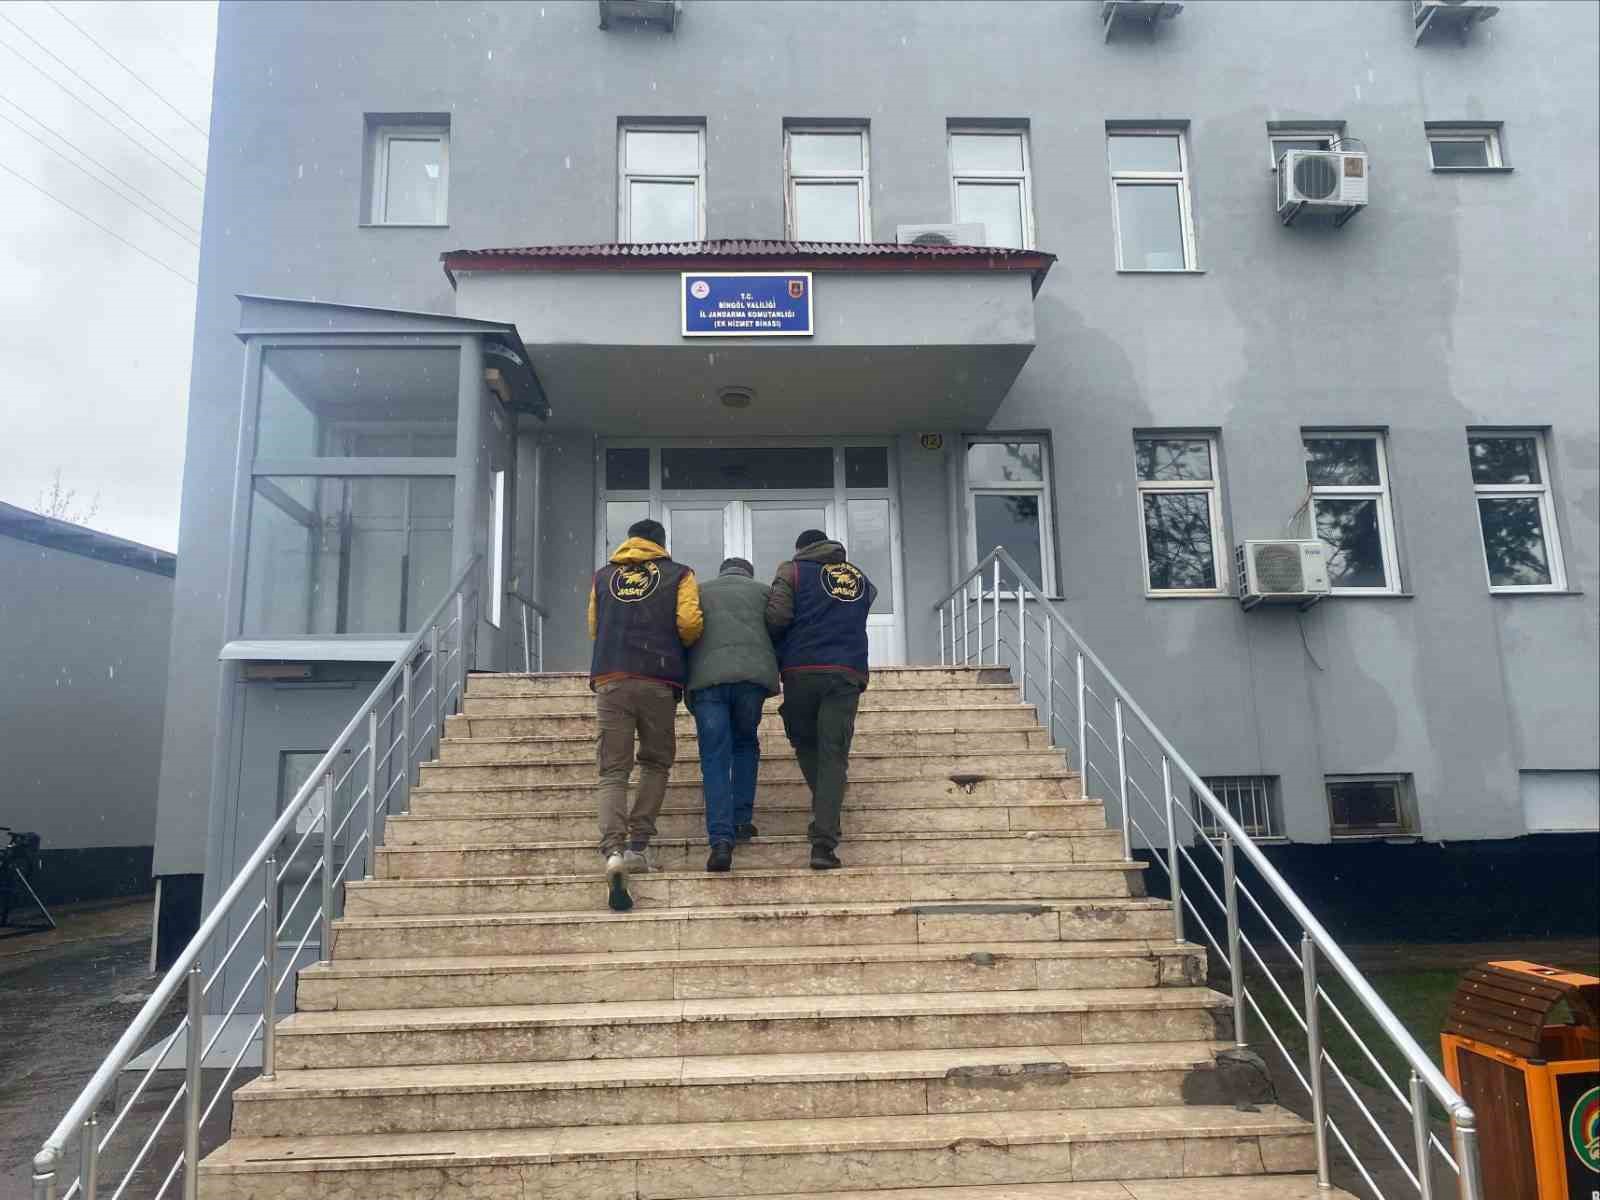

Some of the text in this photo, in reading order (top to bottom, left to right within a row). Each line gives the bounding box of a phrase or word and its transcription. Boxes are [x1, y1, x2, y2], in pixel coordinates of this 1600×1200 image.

[719, 300, 776, 309] BİNGÖL VALİLİĞİ
[699, 310, 706, 318] İL
[747, 310, 795, 318] KOMUTANLIĞI
[714, 319, 781, 328] (EK HİZMET BİNASI)
[617, 588, 645, 596] JASAT
[831, 587, 855, 597] JASAT
